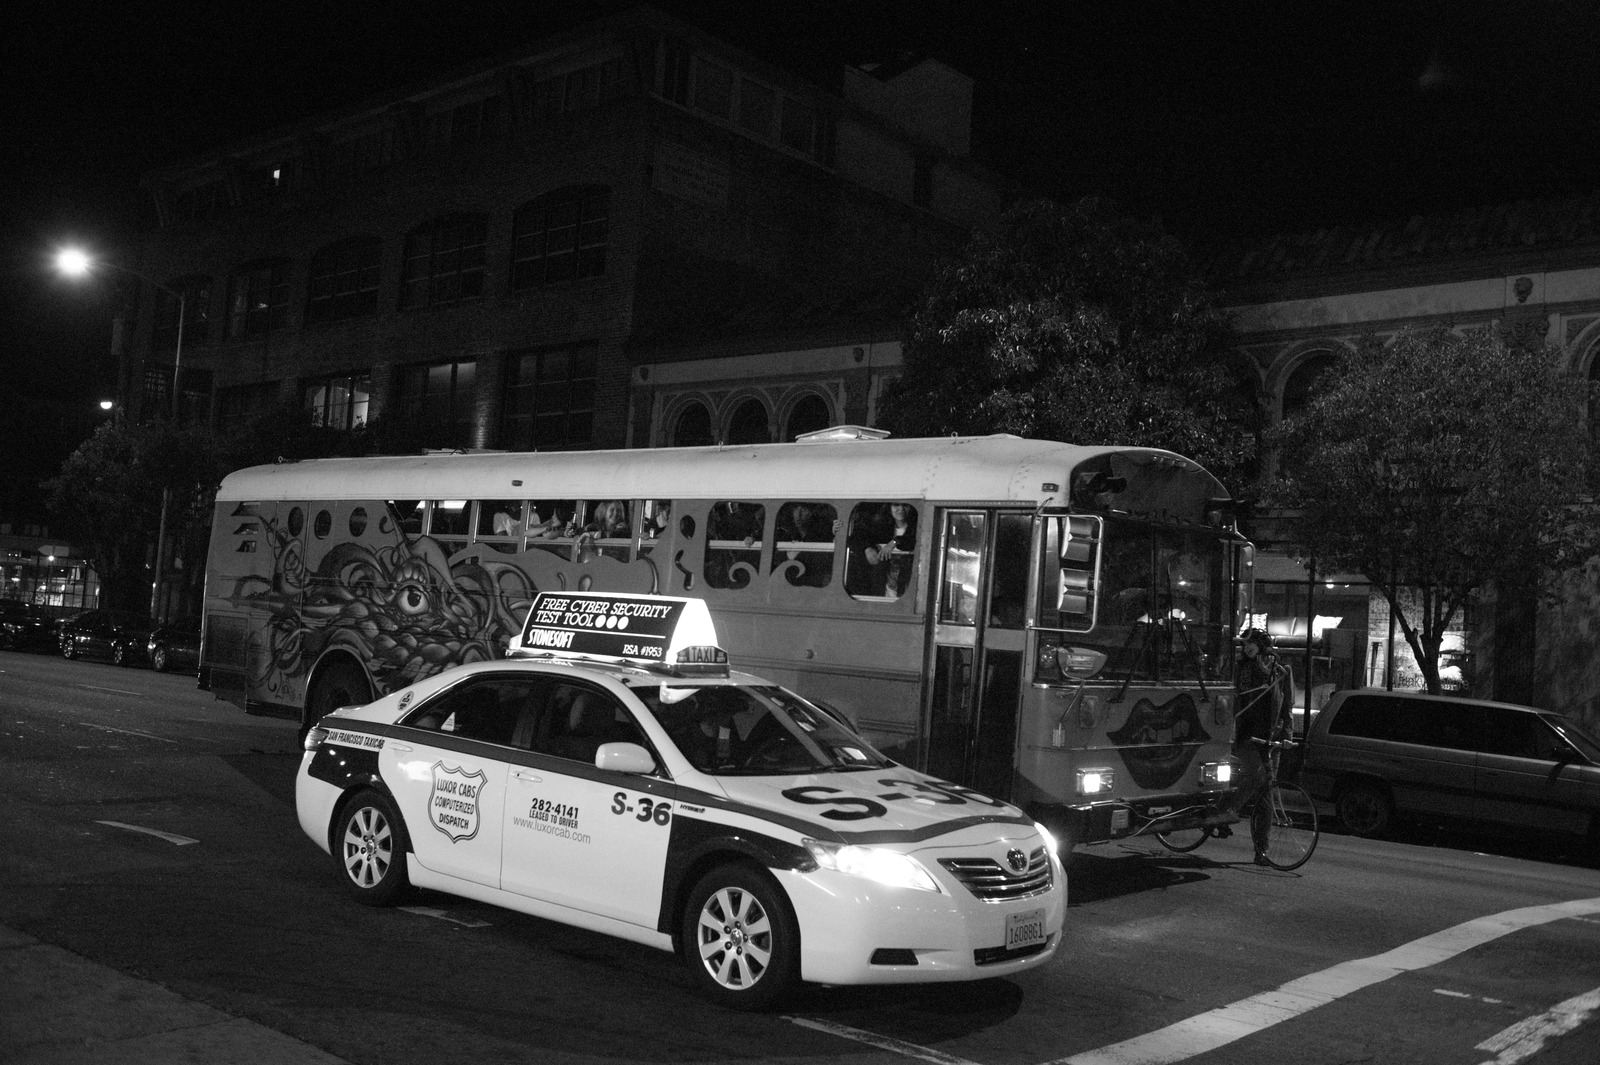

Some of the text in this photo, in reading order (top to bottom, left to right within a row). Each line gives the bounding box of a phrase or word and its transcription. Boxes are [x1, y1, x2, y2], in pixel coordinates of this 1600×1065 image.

[540, 598, 672, 618] FREE CYBER SECURITY
[535, 610, 594, 627] TEST TOOL
[527, 628, 575, 648] STONESOFT
[622, 644, 662, 658] RSA #1953
[691, 647, 715, 661] TAXI
[328, 731, 385, 749] SAN FRANCISCO TAXICAB
[436, 778, 476, 798] LUXOR CABS
[434, 795, 475, 815] COMPUTERIZED
[611, 792, 671, 825] S-36
[439, 813, 469, 829] DISPATCH
[529, 809, 578, 829] LEASED TO DRIVER
[513, 815, 591, 844] www.luxorcab.com
